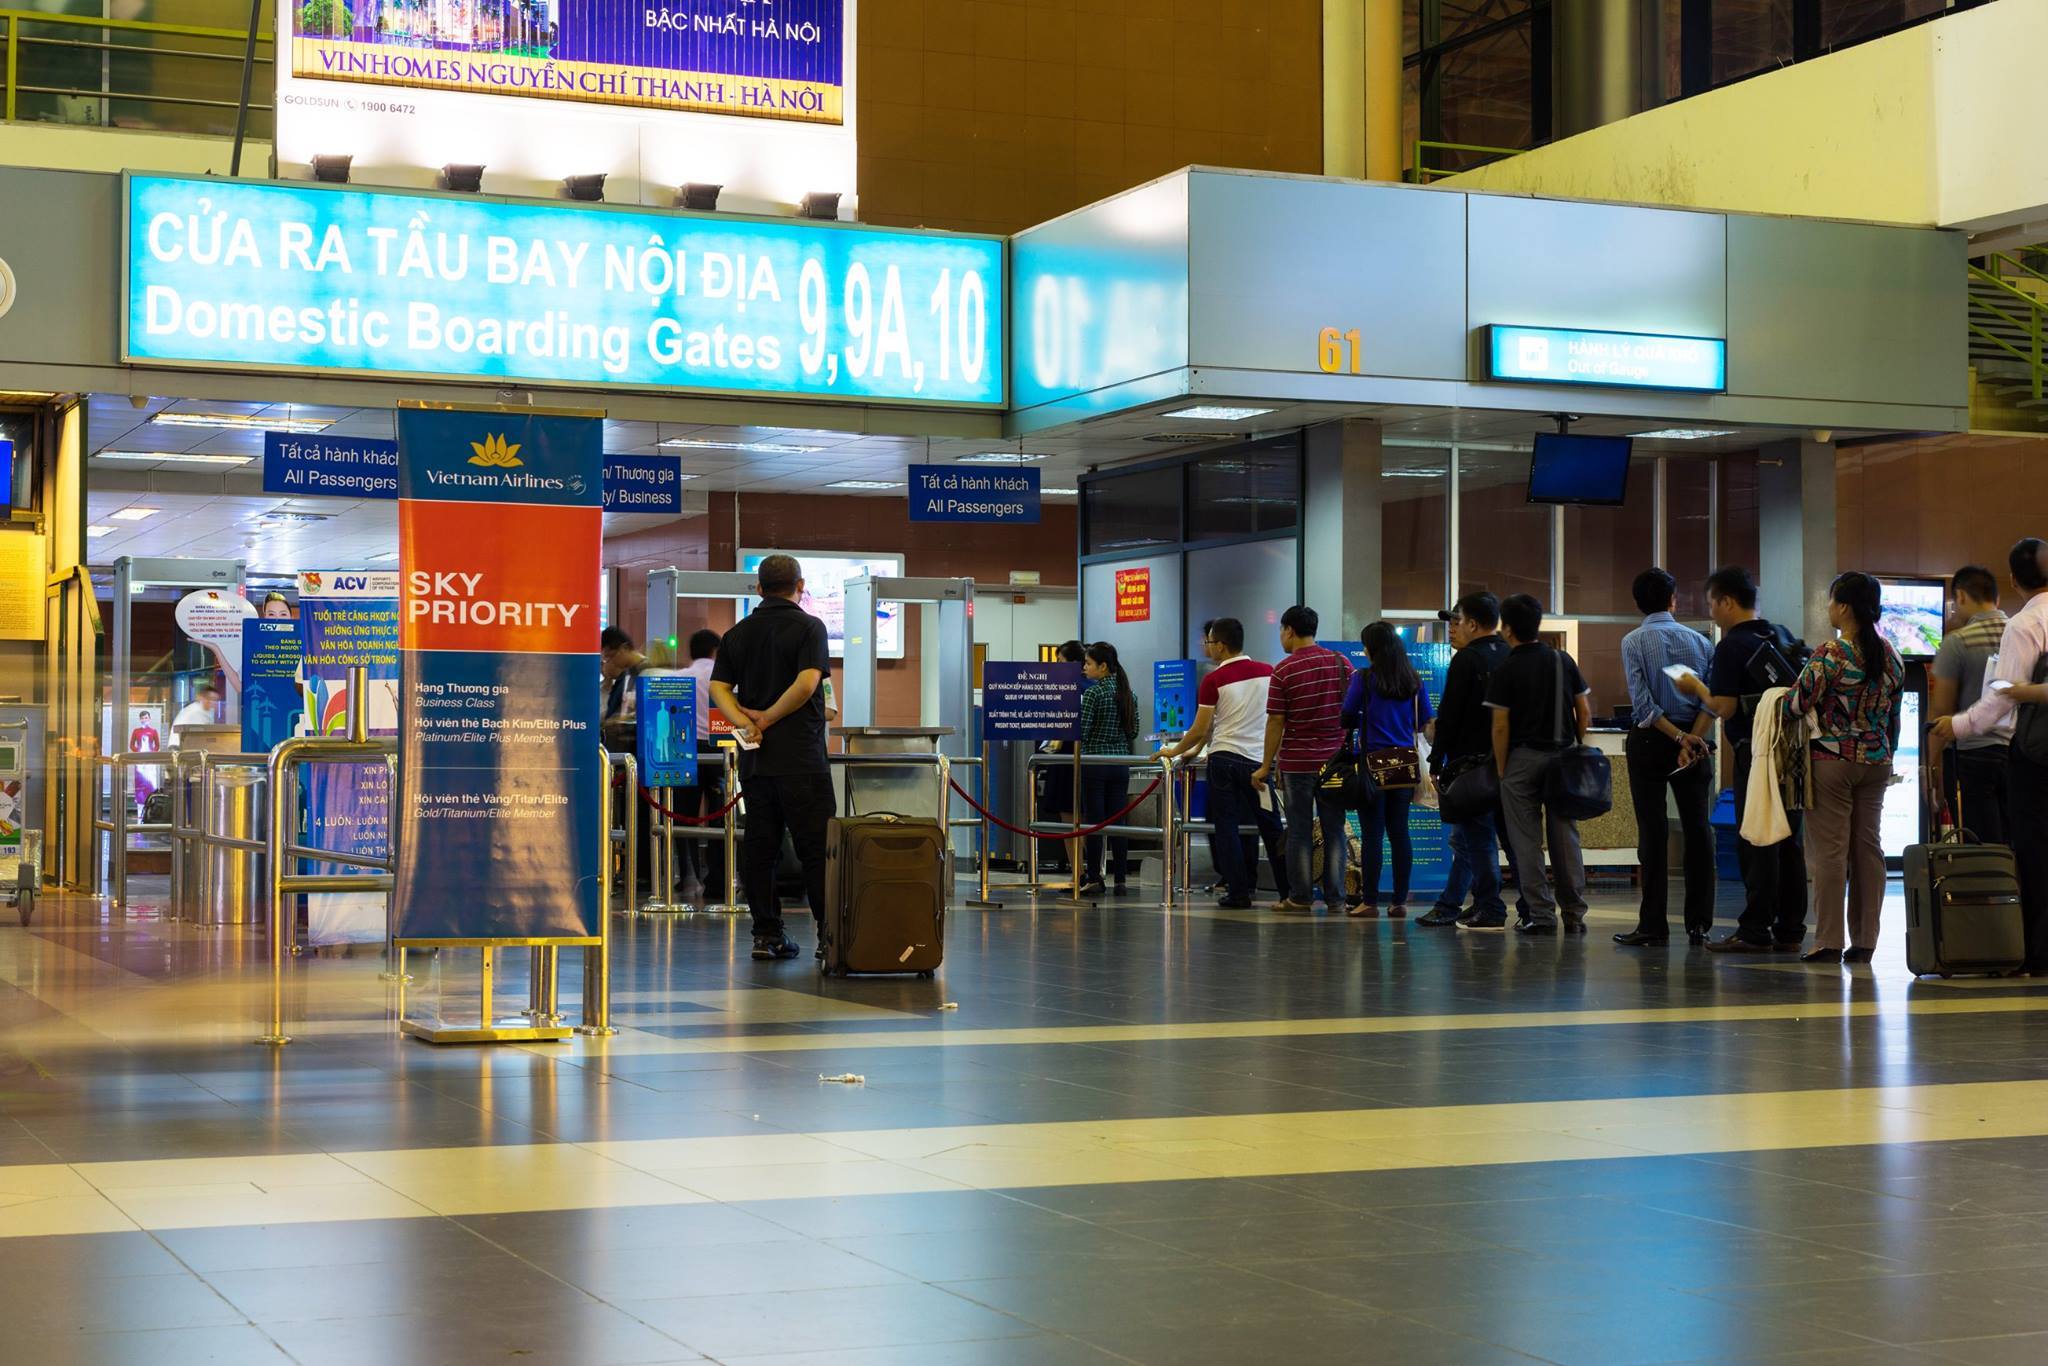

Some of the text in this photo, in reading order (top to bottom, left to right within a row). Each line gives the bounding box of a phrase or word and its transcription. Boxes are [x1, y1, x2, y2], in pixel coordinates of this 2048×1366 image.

[646, 8, 821, 45] BẬC NHẤT HÀ NỘI
[318, 50, 461, 81] VINHOMES
[467, 62, 575, 90] NGUYỄN
[579, 71, 628, 95] CHÍ
[632, 76, 724, 103] THANH
[741, 83, 772, 109] HÀ
[774, 86, 825, 115] NỘI
[284, 94, 416, 115] GOLDSUN 1900 6472
[149, 197, 782, 313] CỬA RA TẦU BAY NỘI ĐỊA
[145, 285, 783, 374] Domestic Boarding Gates
[1317, 326, 1361, 374] 61
[1568, 359, 1591, 374] Out
[279, 442, 302, 460] Tất
[304, 444, 321, 461] cả
[325, 446, 359, 463] hành
[284, 468, 398, 492] All Passengers
[426, 470, 564, 490] Vietnam Airlines
[614, 465, 674, 485] Thương gia
[921, 473, 1029, 491] Tất cả hành khách
[619, 490, 672, 505] Business
[927, 499, 1024, 517] All Passengers
[333, 576, 368, 590] ACV
[409, 570, 484, 597] SKY
[313, 609, 332, 621] TUỔI
[332, 609, 347, 621] TRẺ
[370, 611, 390, 622] HKQT
[408, 599, 581, 628] PRIORITY
[320, 639, 336, 650] VĂN
[356, 640, 384, 650] DOANH
[303, 654, 319, 665] VĂN
[337, 654, 359, 665] CÔNG
[371, 655, 397, 665] TRONG
[1017, 670, 1028, 680] ĐỀ
[414, 682, 444, 695] Hạng
[492, 684, 509, 696] gia
[415, 697, 495, 709] Business Class
[414, 717, 587, 730] Hội viên thẻ Bạch Kim/Elite Plus
[414, 731, 556, 744] Platinum/Elite Plus Member
[363, 766, 377, 775] XIN
[360, 781, 374, 790] XIN
[359, 795, 372, 805] XIN
[413, 793, 569, 806] Hội viên thẻ Vàng/Titan/Elite
[414, 808, 556, 819] Gold/Titanium/Elite Member
[315, 817, 322, 827] 4
[356, 815, 379, 826] LUÔN
[353, 831, 376, 841] LUÔN
